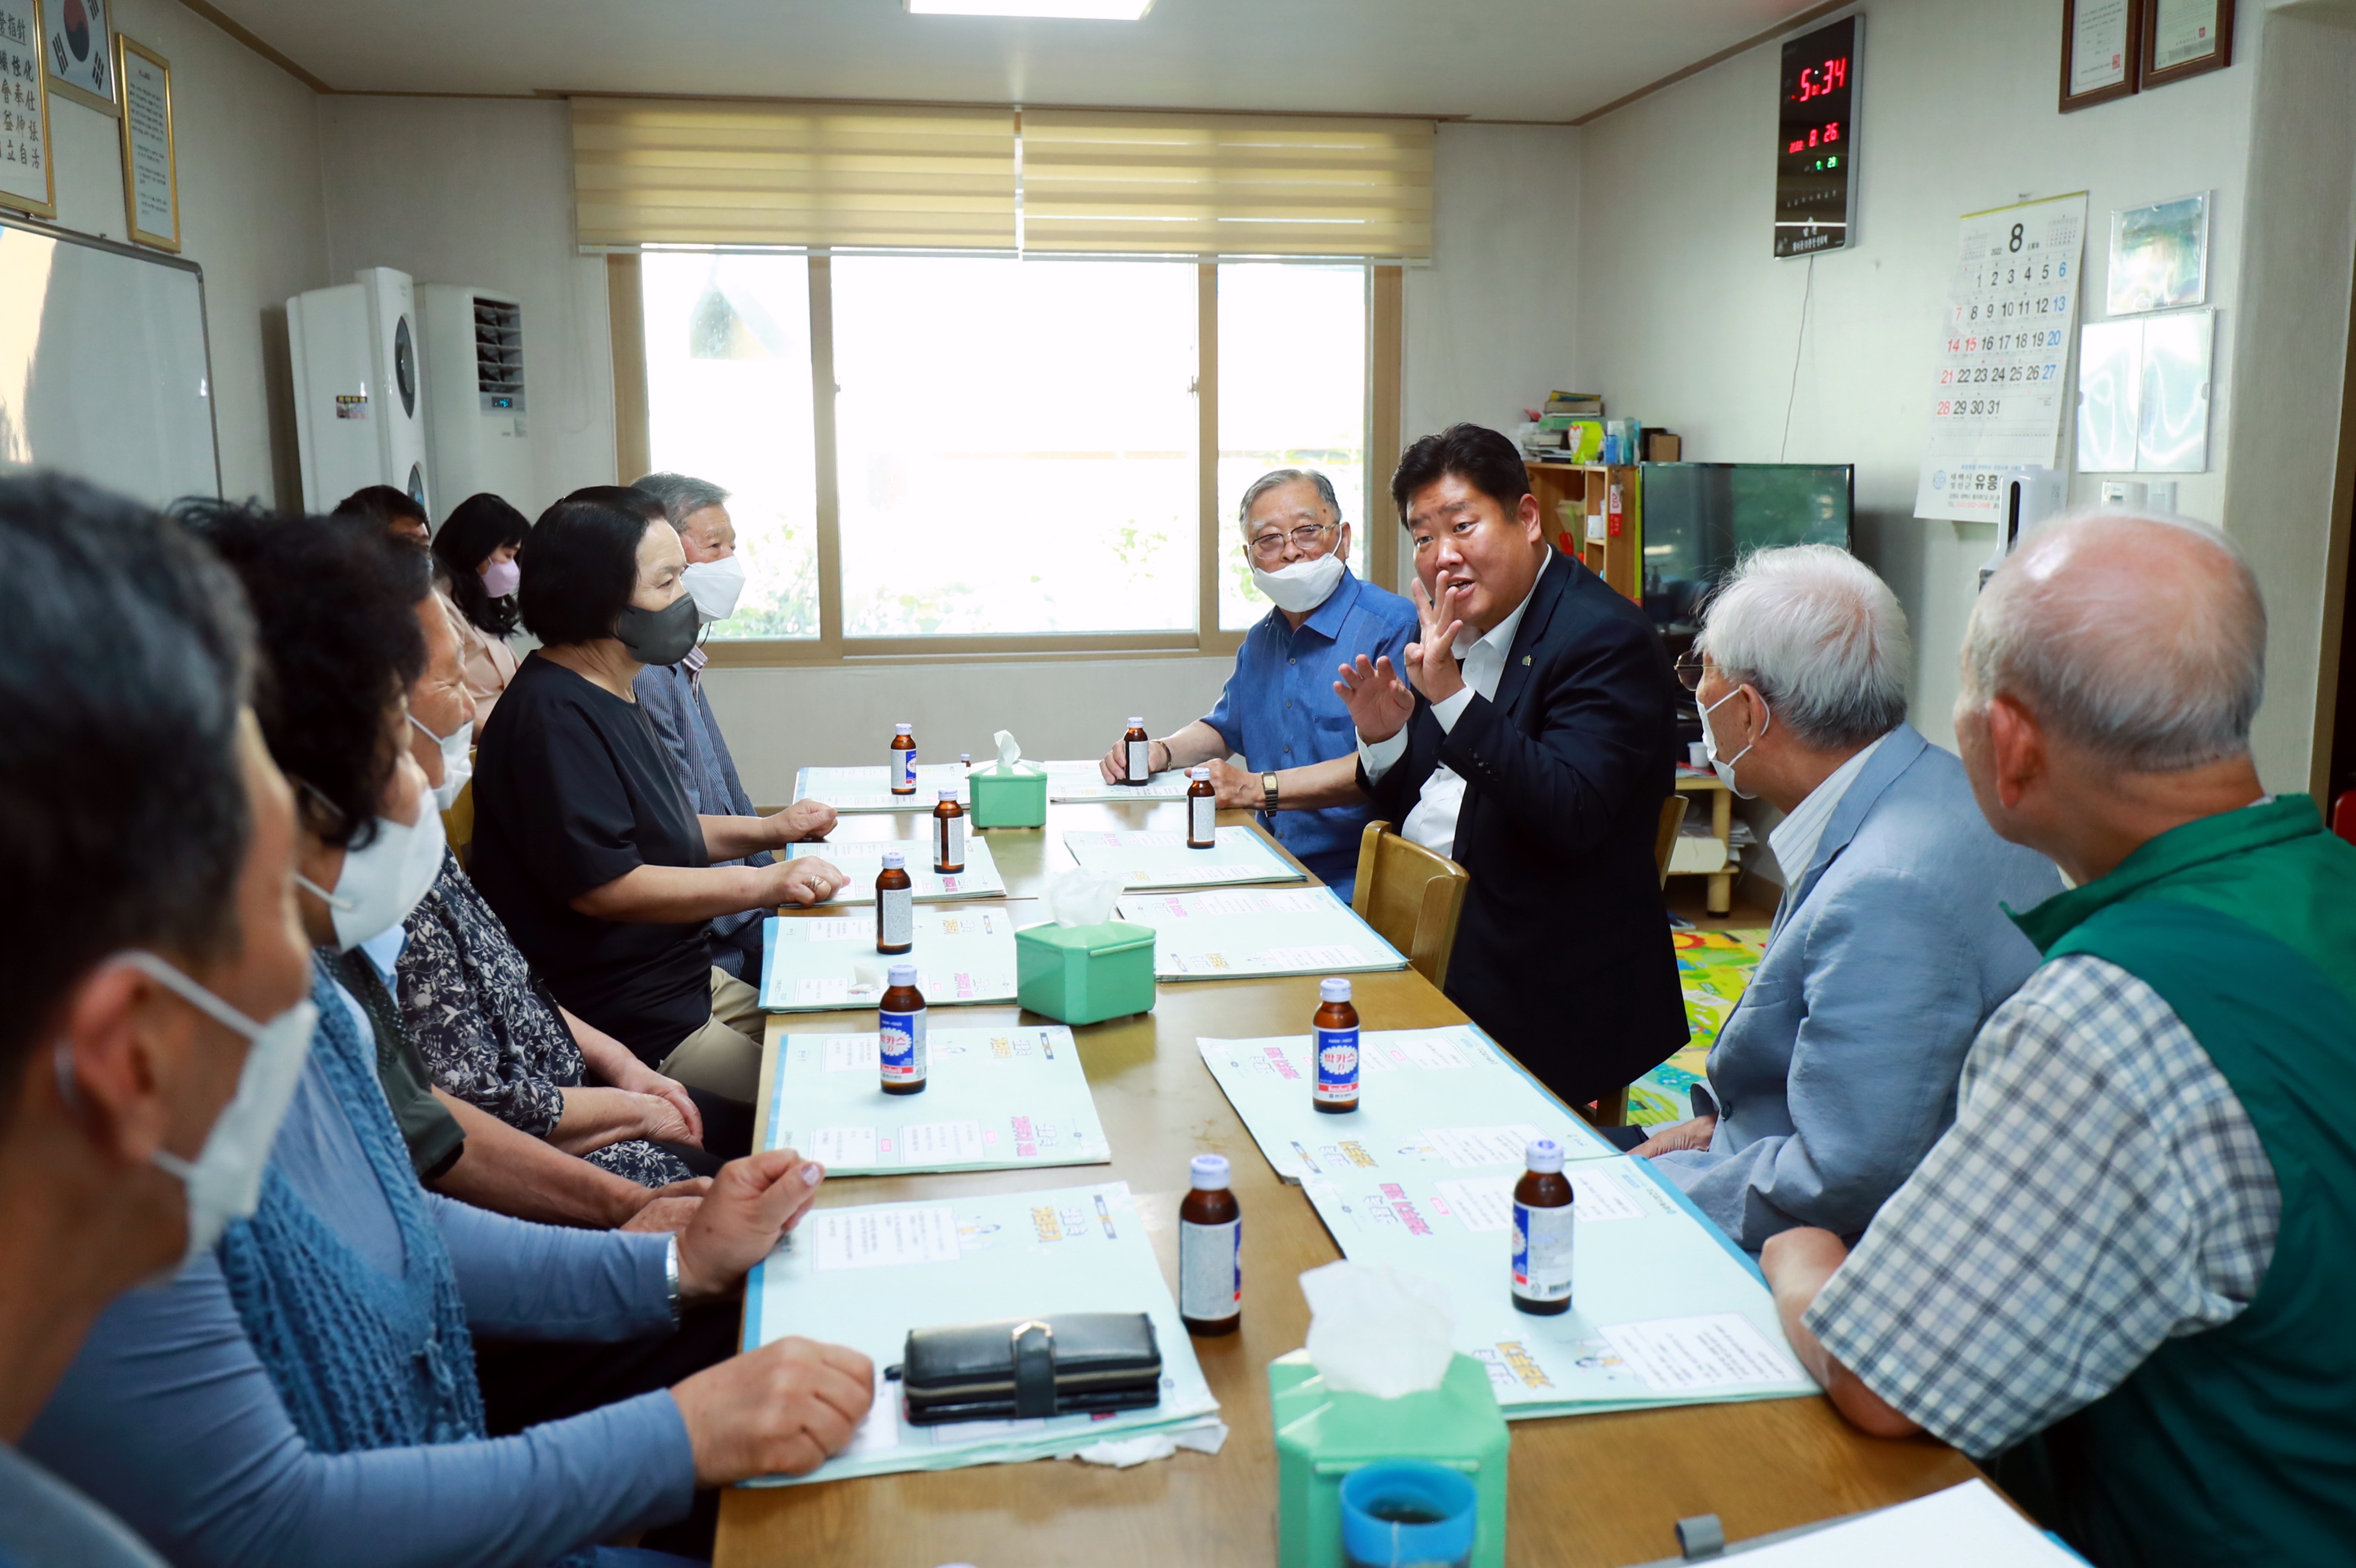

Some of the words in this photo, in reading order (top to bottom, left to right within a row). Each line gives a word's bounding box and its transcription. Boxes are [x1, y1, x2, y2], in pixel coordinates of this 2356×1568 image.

[2009, 223, 2024, 252] 8
[1977, 273, 1982, 287] 1
[1991, 271, 1999, 286] 2
[2008, 269, 2015, 283] 3
[2024, 266, 2031, 281] 4
[2042, 264, 2049, 279] 5
[2059, 261, 2067, 277] 6
[1956, 307, 1962, 321] 7
[1971, 305, 1978, 320] 8
[1987, 304, 1994, 318] 9
[2001, 302, 2014, 316] 10
[2019, 300, 2030, 315] 11
[2036, 298, 2048, 313] 12
[2053, 296, 2066, 312] 13
[1947, 339, 1960, 352] 14
[1965, 337, 1977, 351] 15
[1982, 336, 1994, 350] 16
[1999, 335, 2011, 349] 17
[2015, 333, 2027, 348] 18
[2032, 331, 2044, 347] 19
[2047, 330, 2061, 346] 20
[1941, 369, 1953, 384] 21
[1957, 368, 1971, 383] 22
[1974, 368, 1988, 382] 23
[1991, 367, 2005, 382] 24
[2009, 366, 2022, 381] 25
[2026, 365, 2040, 381] 26
[2042, 364, 2056, 379] 27
[1937, 401, 1951, 415] 28
[1953, 400, 1967, 415] 29
[1970, 400, 1984, 414] 30
[1987, 399, 2000, 414] 31
[1324, 1052, 1355, 1064] 박카스
